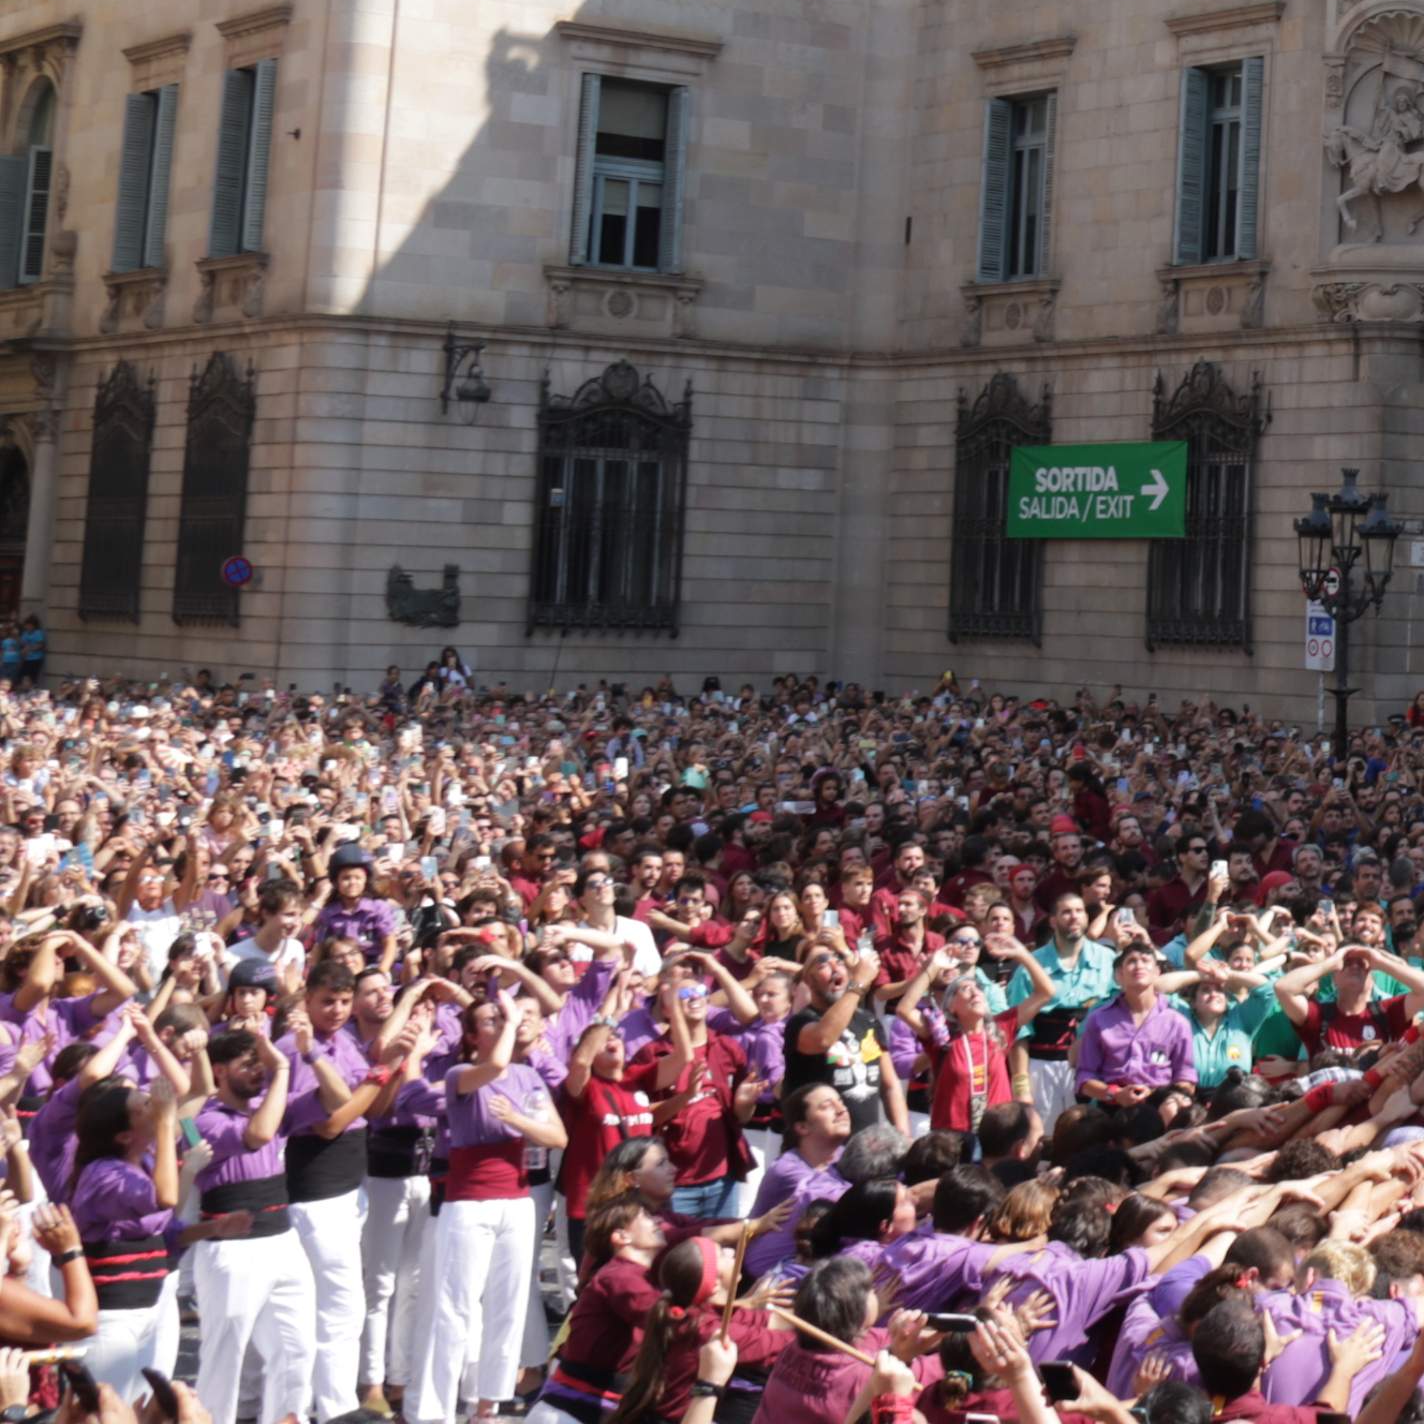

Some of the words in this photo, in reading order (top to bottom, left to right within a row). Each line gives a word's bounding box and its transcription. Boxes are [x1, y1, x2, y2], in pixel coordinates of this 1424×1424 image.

[1035, 465, 1119, 493] SORTIDA
[1018, 496, 1080, 520] SALIDA
[1095, 495, 1135, 519] EXIT
